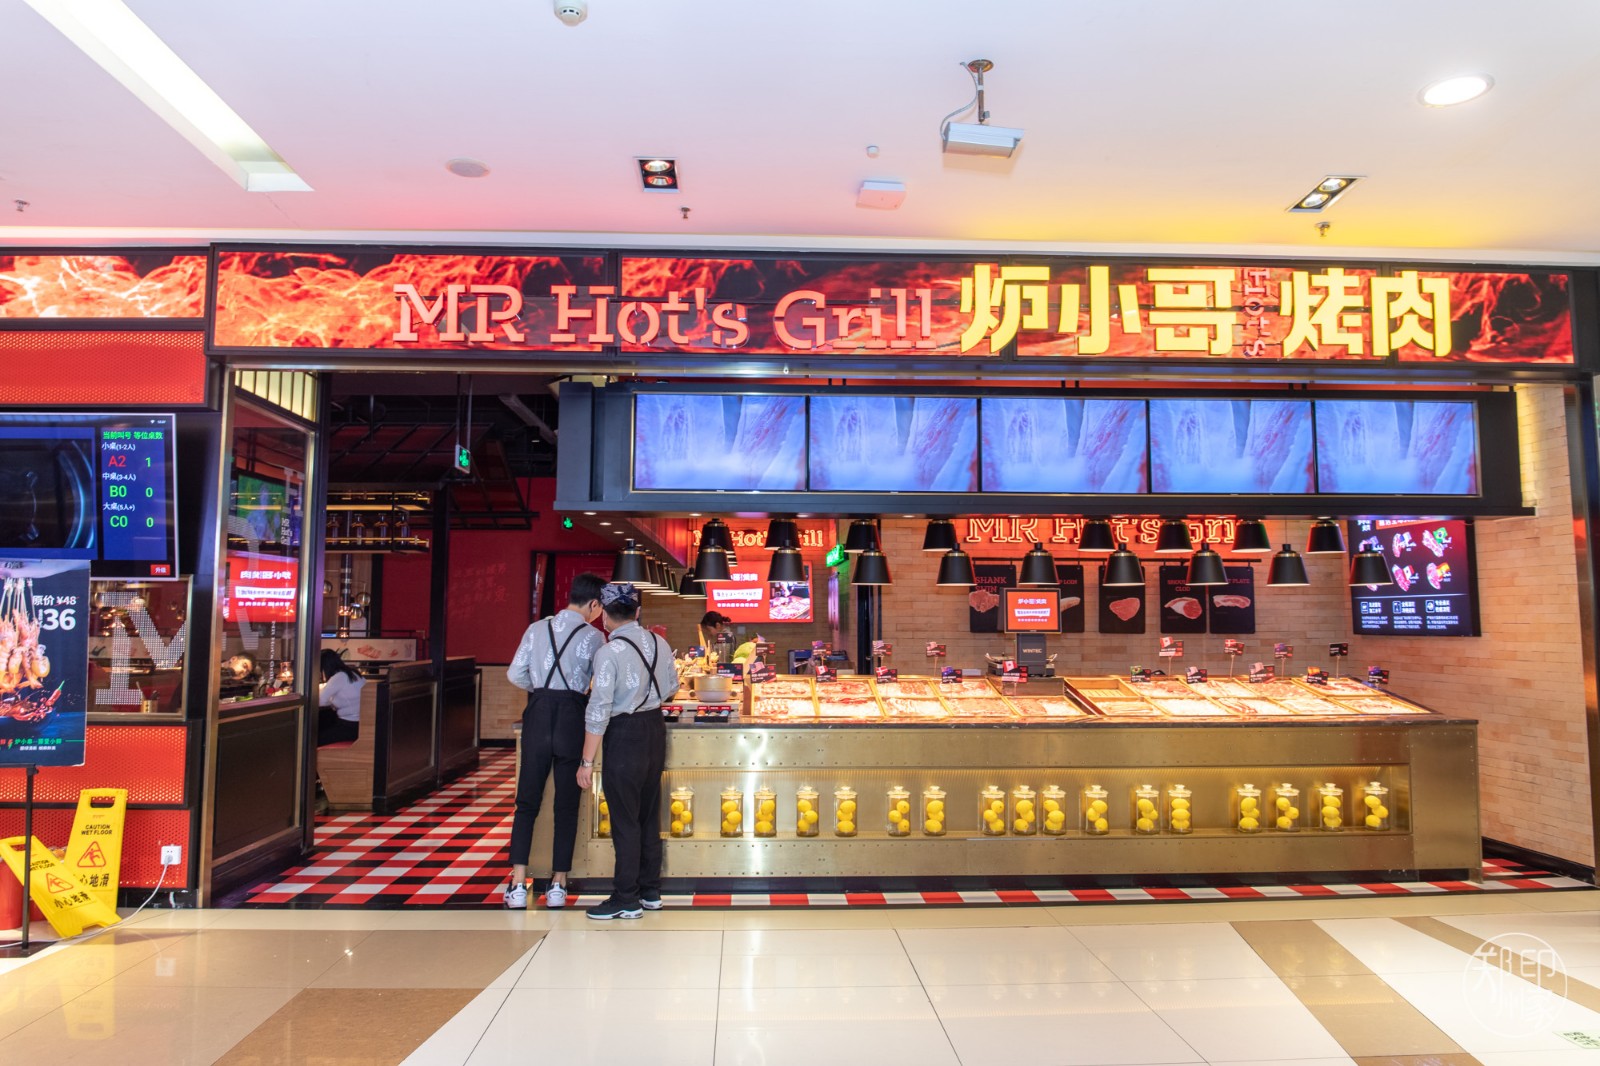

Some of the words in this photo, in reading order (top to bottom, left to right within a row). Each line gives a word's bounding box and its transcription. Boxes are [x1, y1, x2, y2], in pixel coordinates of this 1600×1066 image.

[393, 283, 525, 343] MR
[549, 284, 751, 348] Hot's
[773, 286, 938, 350] Grill
[959, 263, 1238, 356] 炉小哥
[1279, 266, 1453, 357] 烤肉
[102, 431, 132, 440] 当前叫号
[133, 431, 164, 440] 等位桌数
[108, 456, 127, 467] A2
[145, 457, 151, 467] 1
[109, 485, 127, 498] B0
[145, 487, 153, 498] 0
[109, 515, 128, 528] C0
[146, 517, 154, 528] 0
[966, 518, 1039, 543] MR
[1052, 517, 1161, 544] Ht's
[32, 595, 55, 606] 原价
[42, 608, 76, 631] 36
[79, 873, 110, 888] 心地滑
